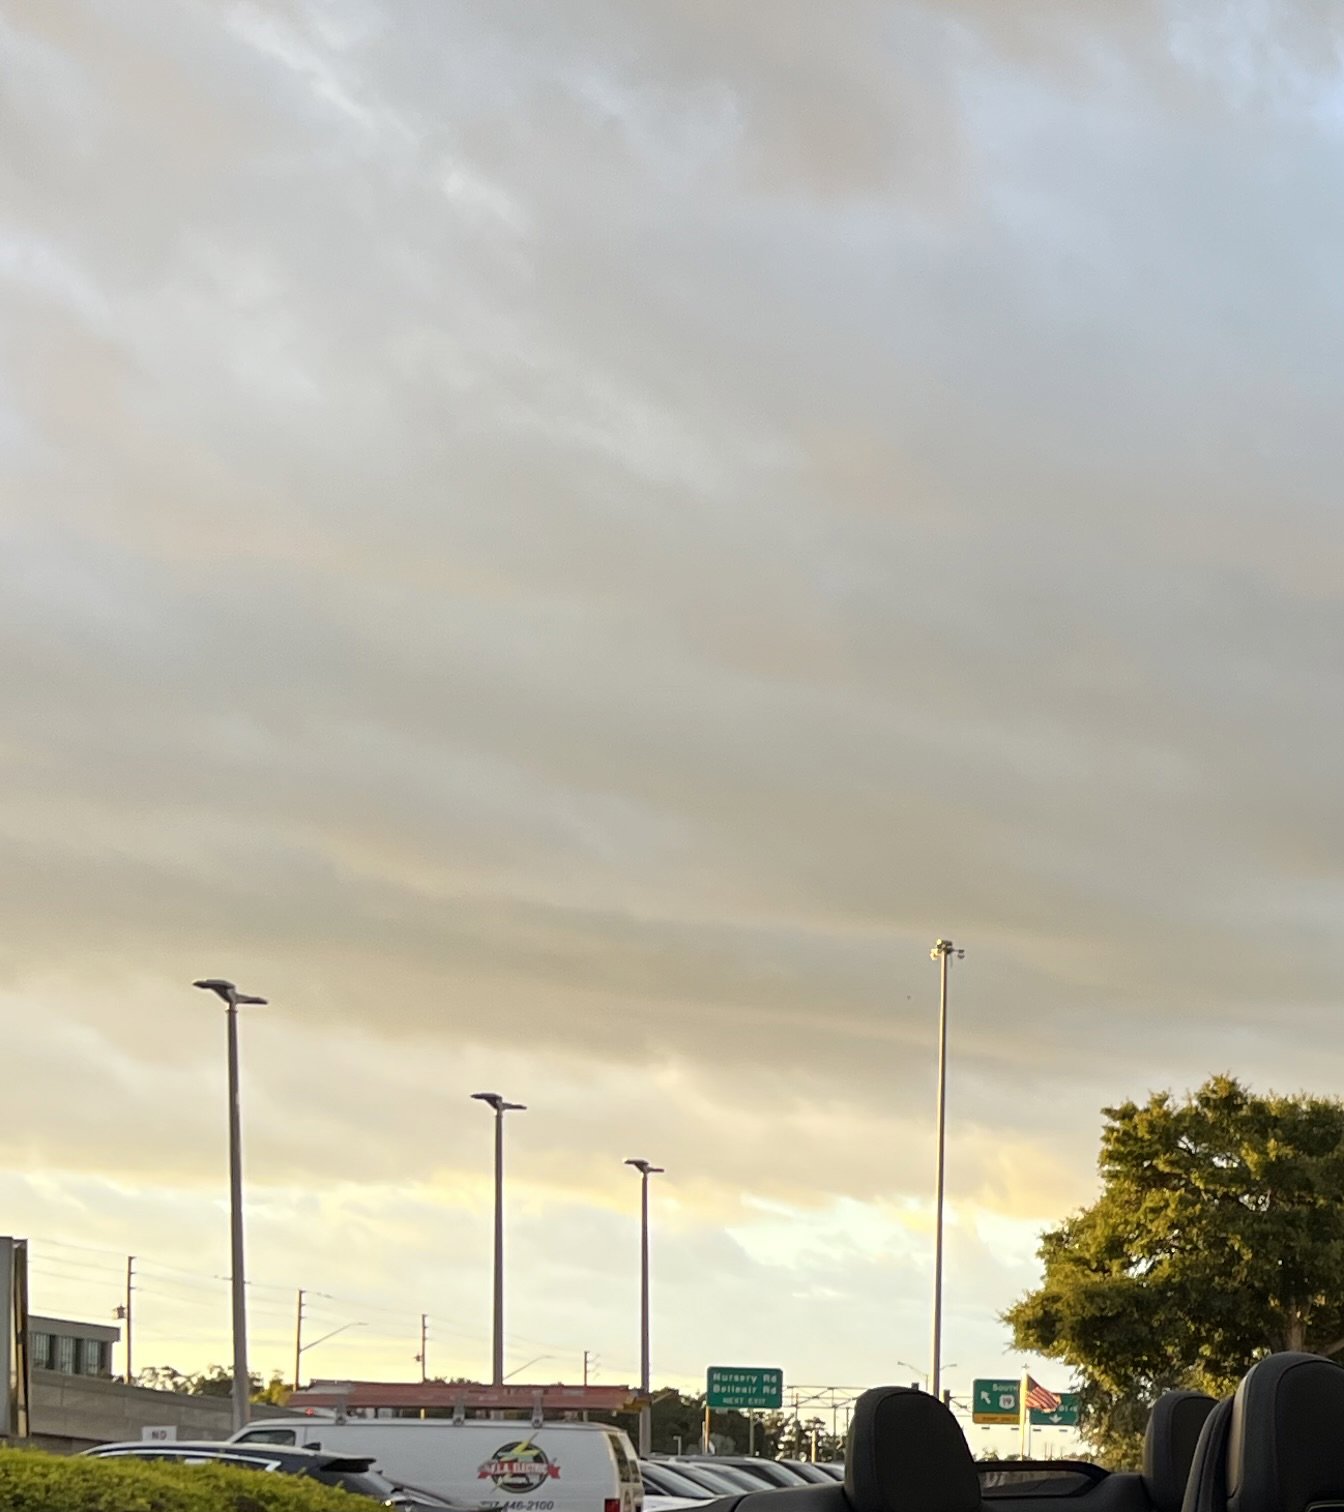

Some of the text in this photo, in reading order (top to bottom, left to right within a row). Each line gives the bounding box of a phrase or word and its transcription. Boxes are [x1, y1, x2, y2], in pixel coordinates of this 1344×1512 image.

[713, 1373, 777, 1384] Nursery Rd
[763, 1385, 777, 1395] Rd
